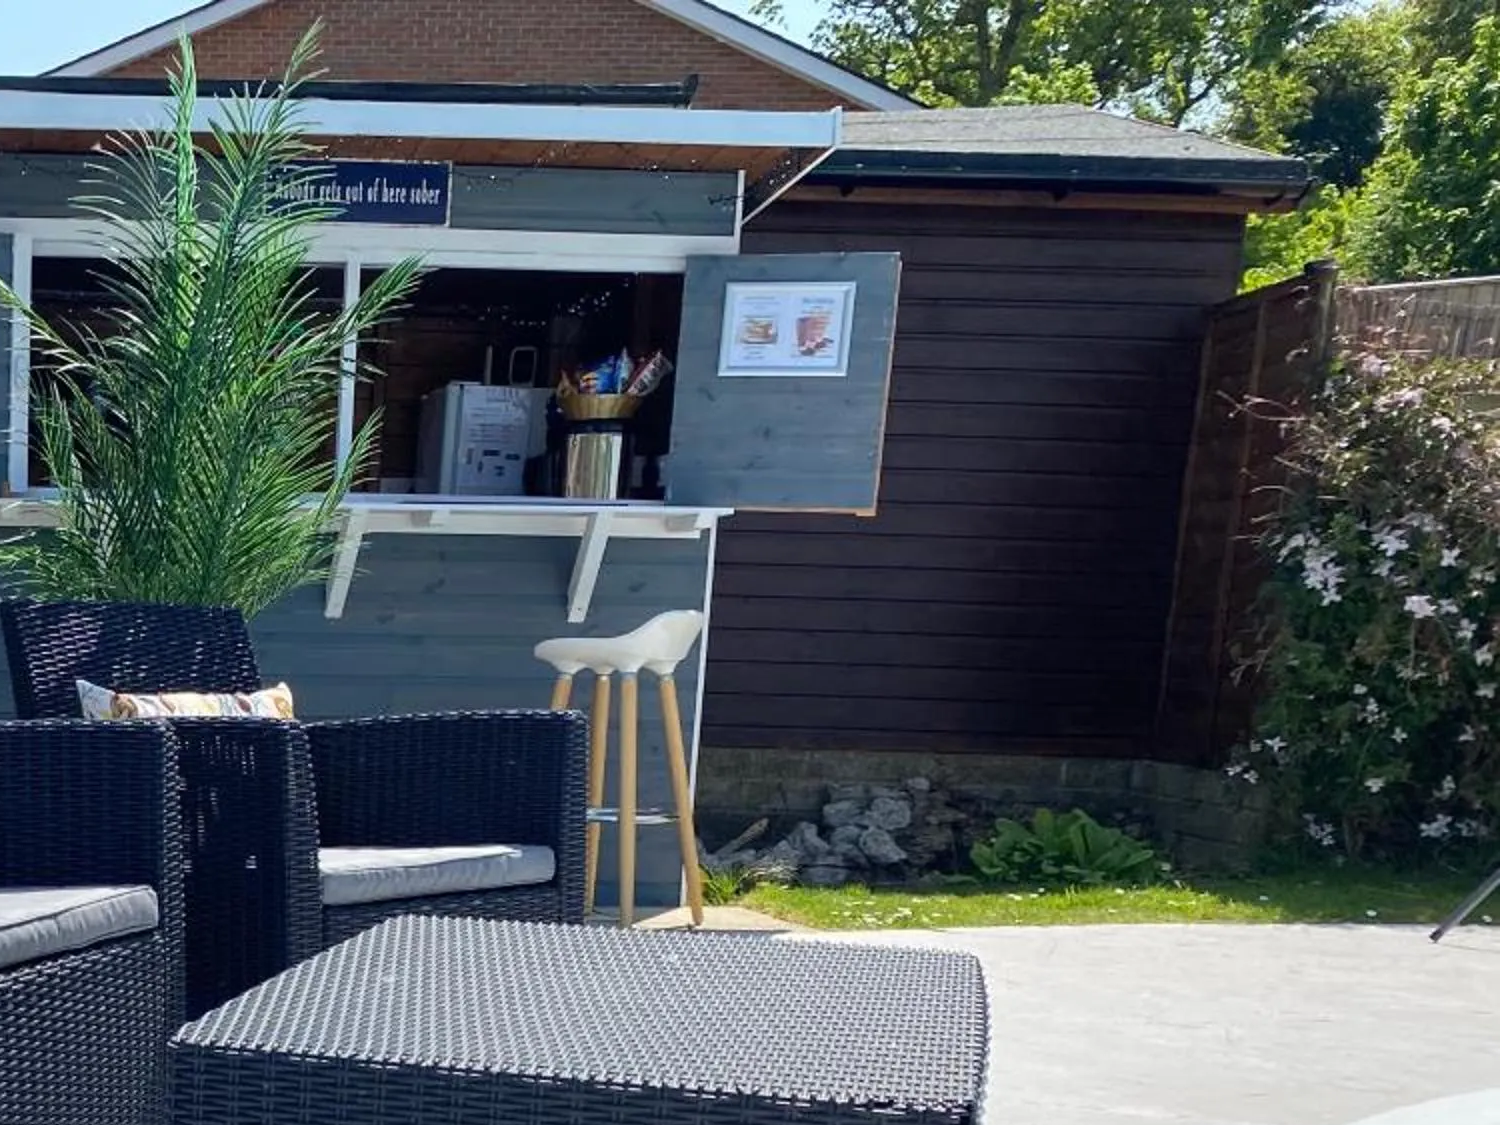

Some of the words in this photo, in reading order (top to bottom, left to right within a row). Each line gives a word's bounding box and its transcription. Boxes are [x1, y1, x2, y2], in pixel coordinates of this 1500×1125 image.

[319, 179, 341, 205] gets
[346, 181, 363, 203] out
[365, 177, 380, 203] of
[381, 177, 406, 203] here
[410, 178, 440, 204] sober
